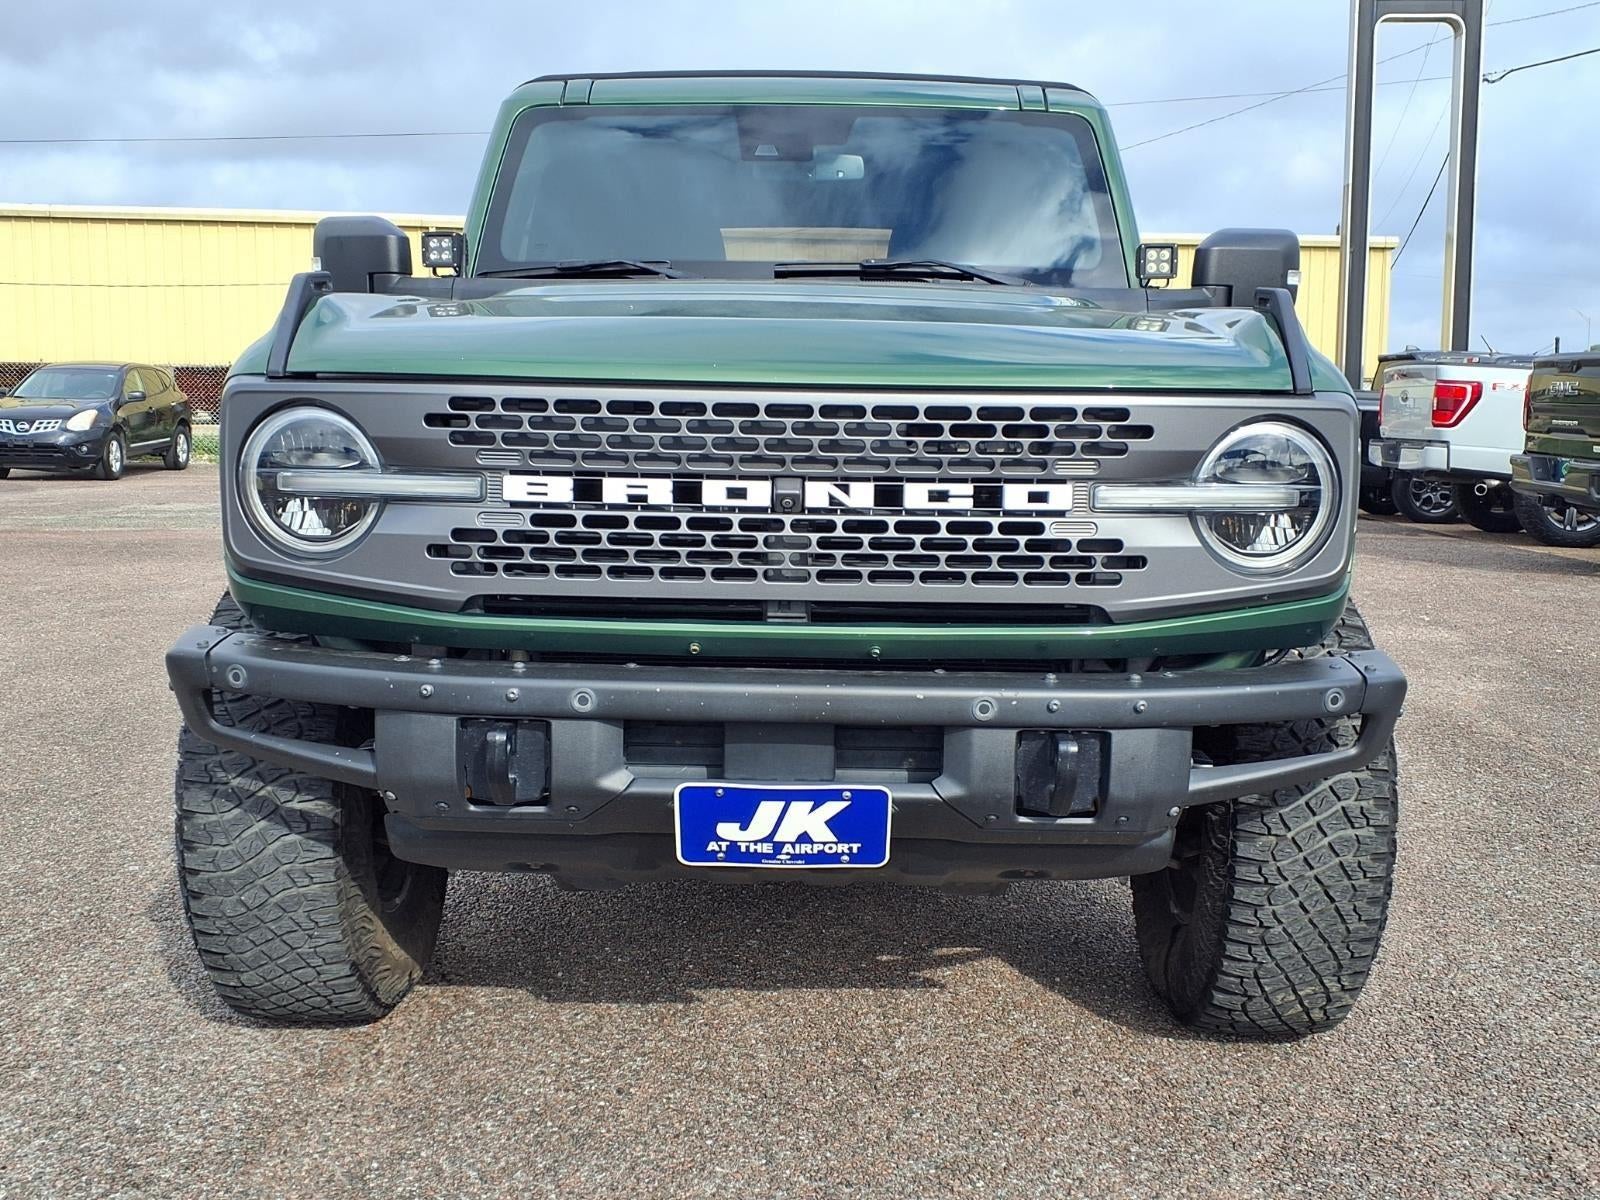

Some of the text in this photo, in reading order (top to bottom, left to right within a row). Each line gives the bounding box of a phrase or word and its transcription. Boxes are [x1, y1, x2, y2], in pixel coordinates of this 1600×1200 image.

[1492, 382, 1528, 393] FX
[502, 475, 1074, 510] BRONCO
[716, 801, 852, 842] JK
[706, 842, 861, 854] AT THE AIRPORT
